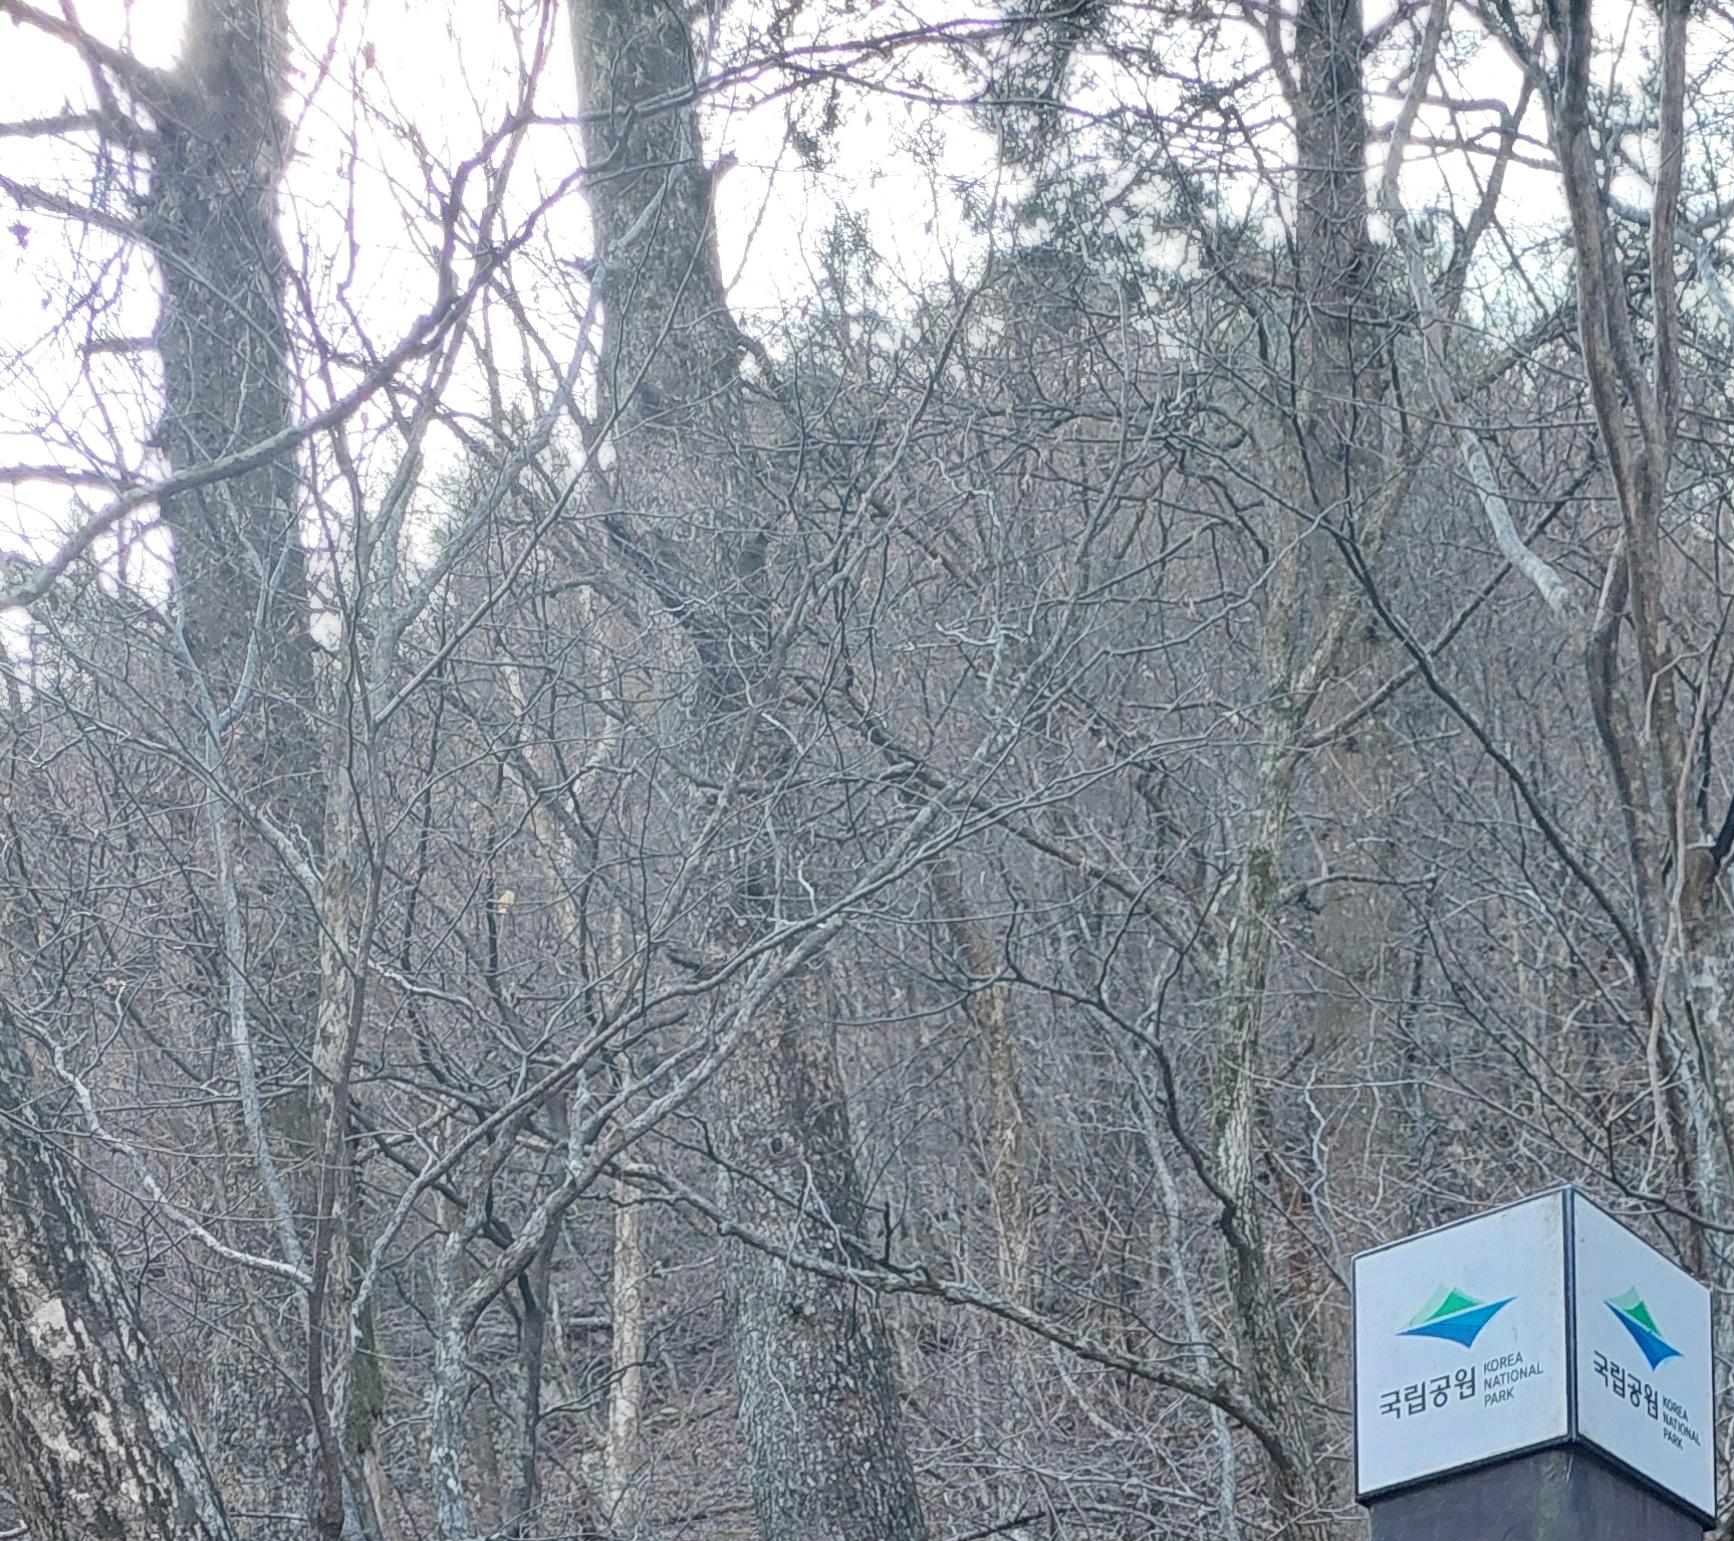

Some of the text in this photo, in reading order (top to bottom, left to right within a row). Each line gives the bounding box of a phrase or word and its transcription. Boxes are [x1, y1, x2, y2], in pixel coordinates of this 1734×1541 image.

[1483, 1351, 1524, 1375] KOREA
[1483, 1362, 1545, 1391] NATIONAL
[1379, 1365, 1477, 1420] 국립공원
[1483, 1386, 1516, 1408] PARK
[1593, 1350, 1659, 1421] 국립공원
[1662, 1395, 1689, 1422] KOREA
[1662, 1411, 1702, 1447] NATIONAL
[1662, 1427, 1684, 1451] PARK
